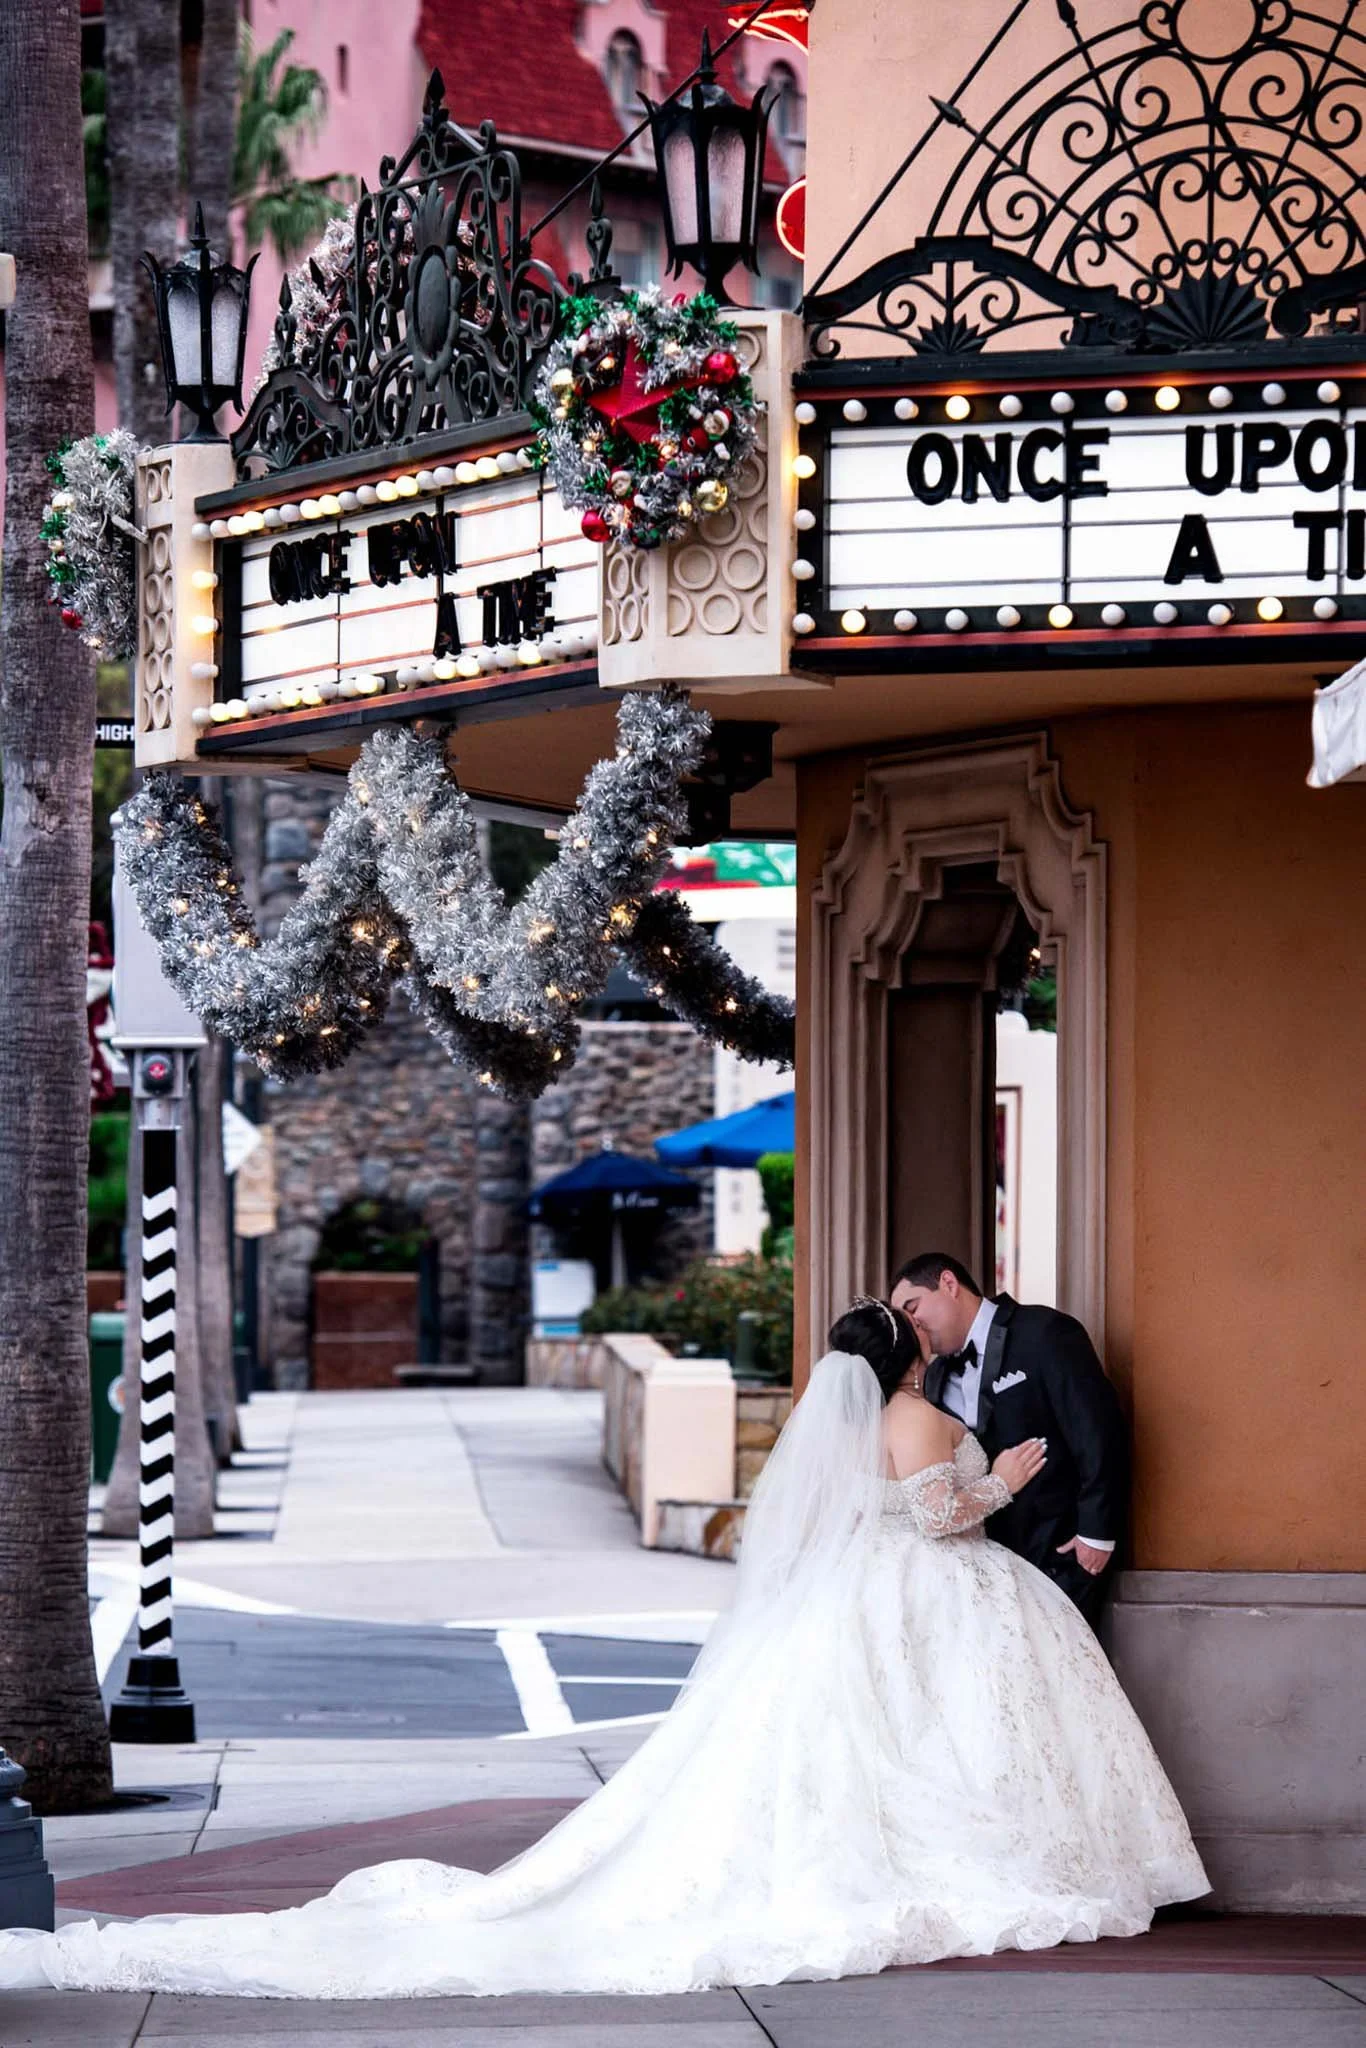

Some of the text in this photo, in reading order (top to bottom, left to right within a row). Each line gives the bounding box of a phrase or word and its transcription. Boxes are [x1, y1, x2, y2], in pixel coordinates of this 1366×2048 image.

[907, 423, 1110, 505] ONCE
[1164, 514, 1224, 585] A
[433, 592, 462, 660] A
[95, 724, 135, 741] HIGH
